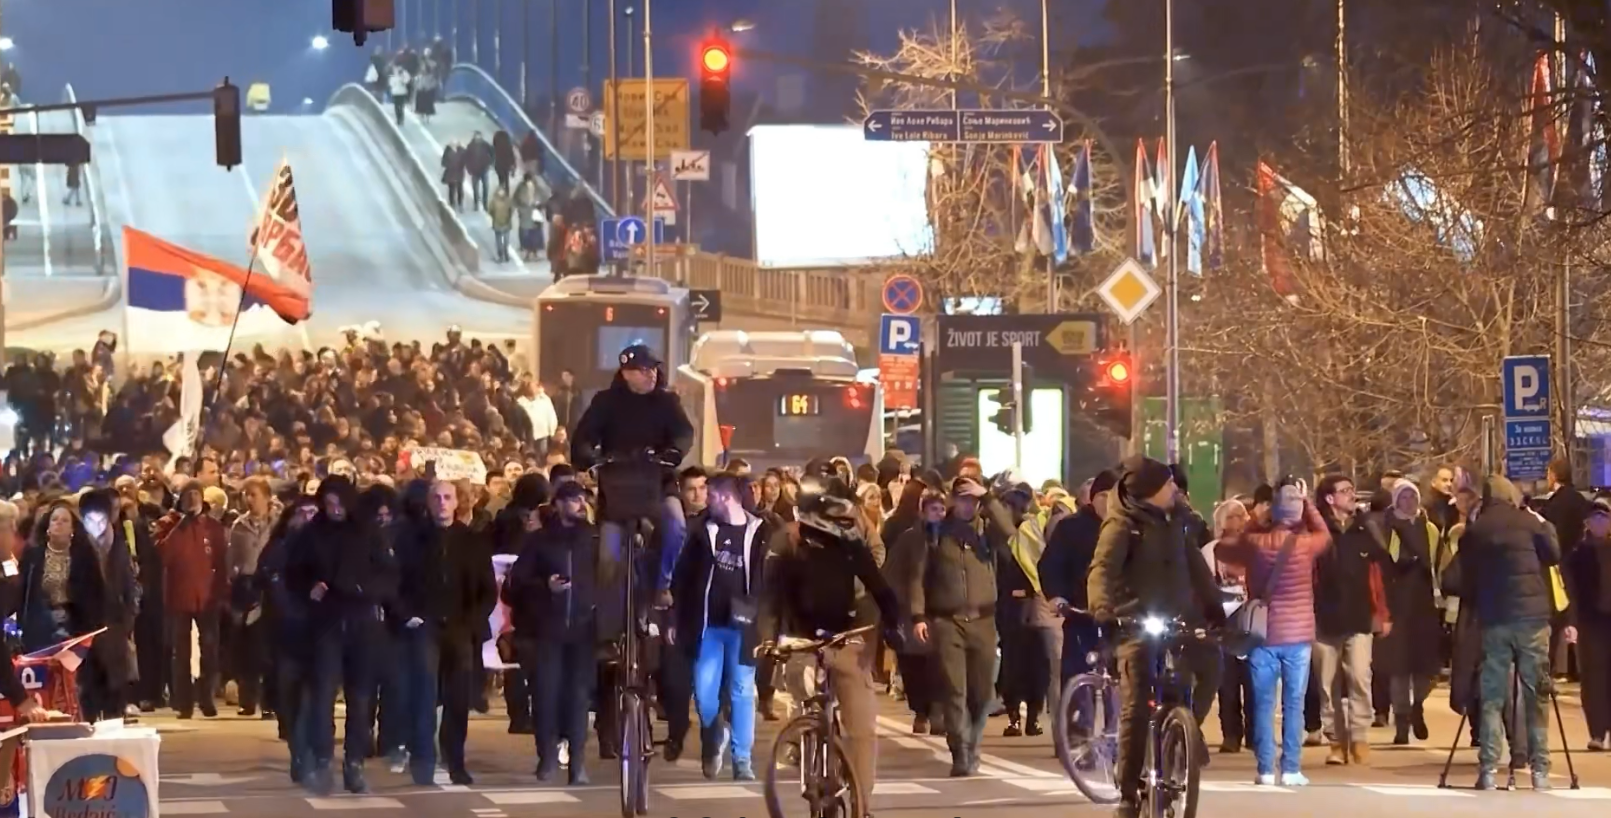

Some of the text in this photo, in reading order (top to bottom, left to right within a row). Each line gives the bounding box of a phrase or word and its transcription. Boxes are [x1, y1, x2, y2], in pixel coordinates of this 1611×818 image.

[889, 320, 911, 350] P
[947, 328, 983, 348] ŽIVOT
[985, 331, 999, 347] JE
[1001, 330, 1041, 347] SPORT
[1513, 365, 1539, 410] P
[792, 395, 808, 414] 64
